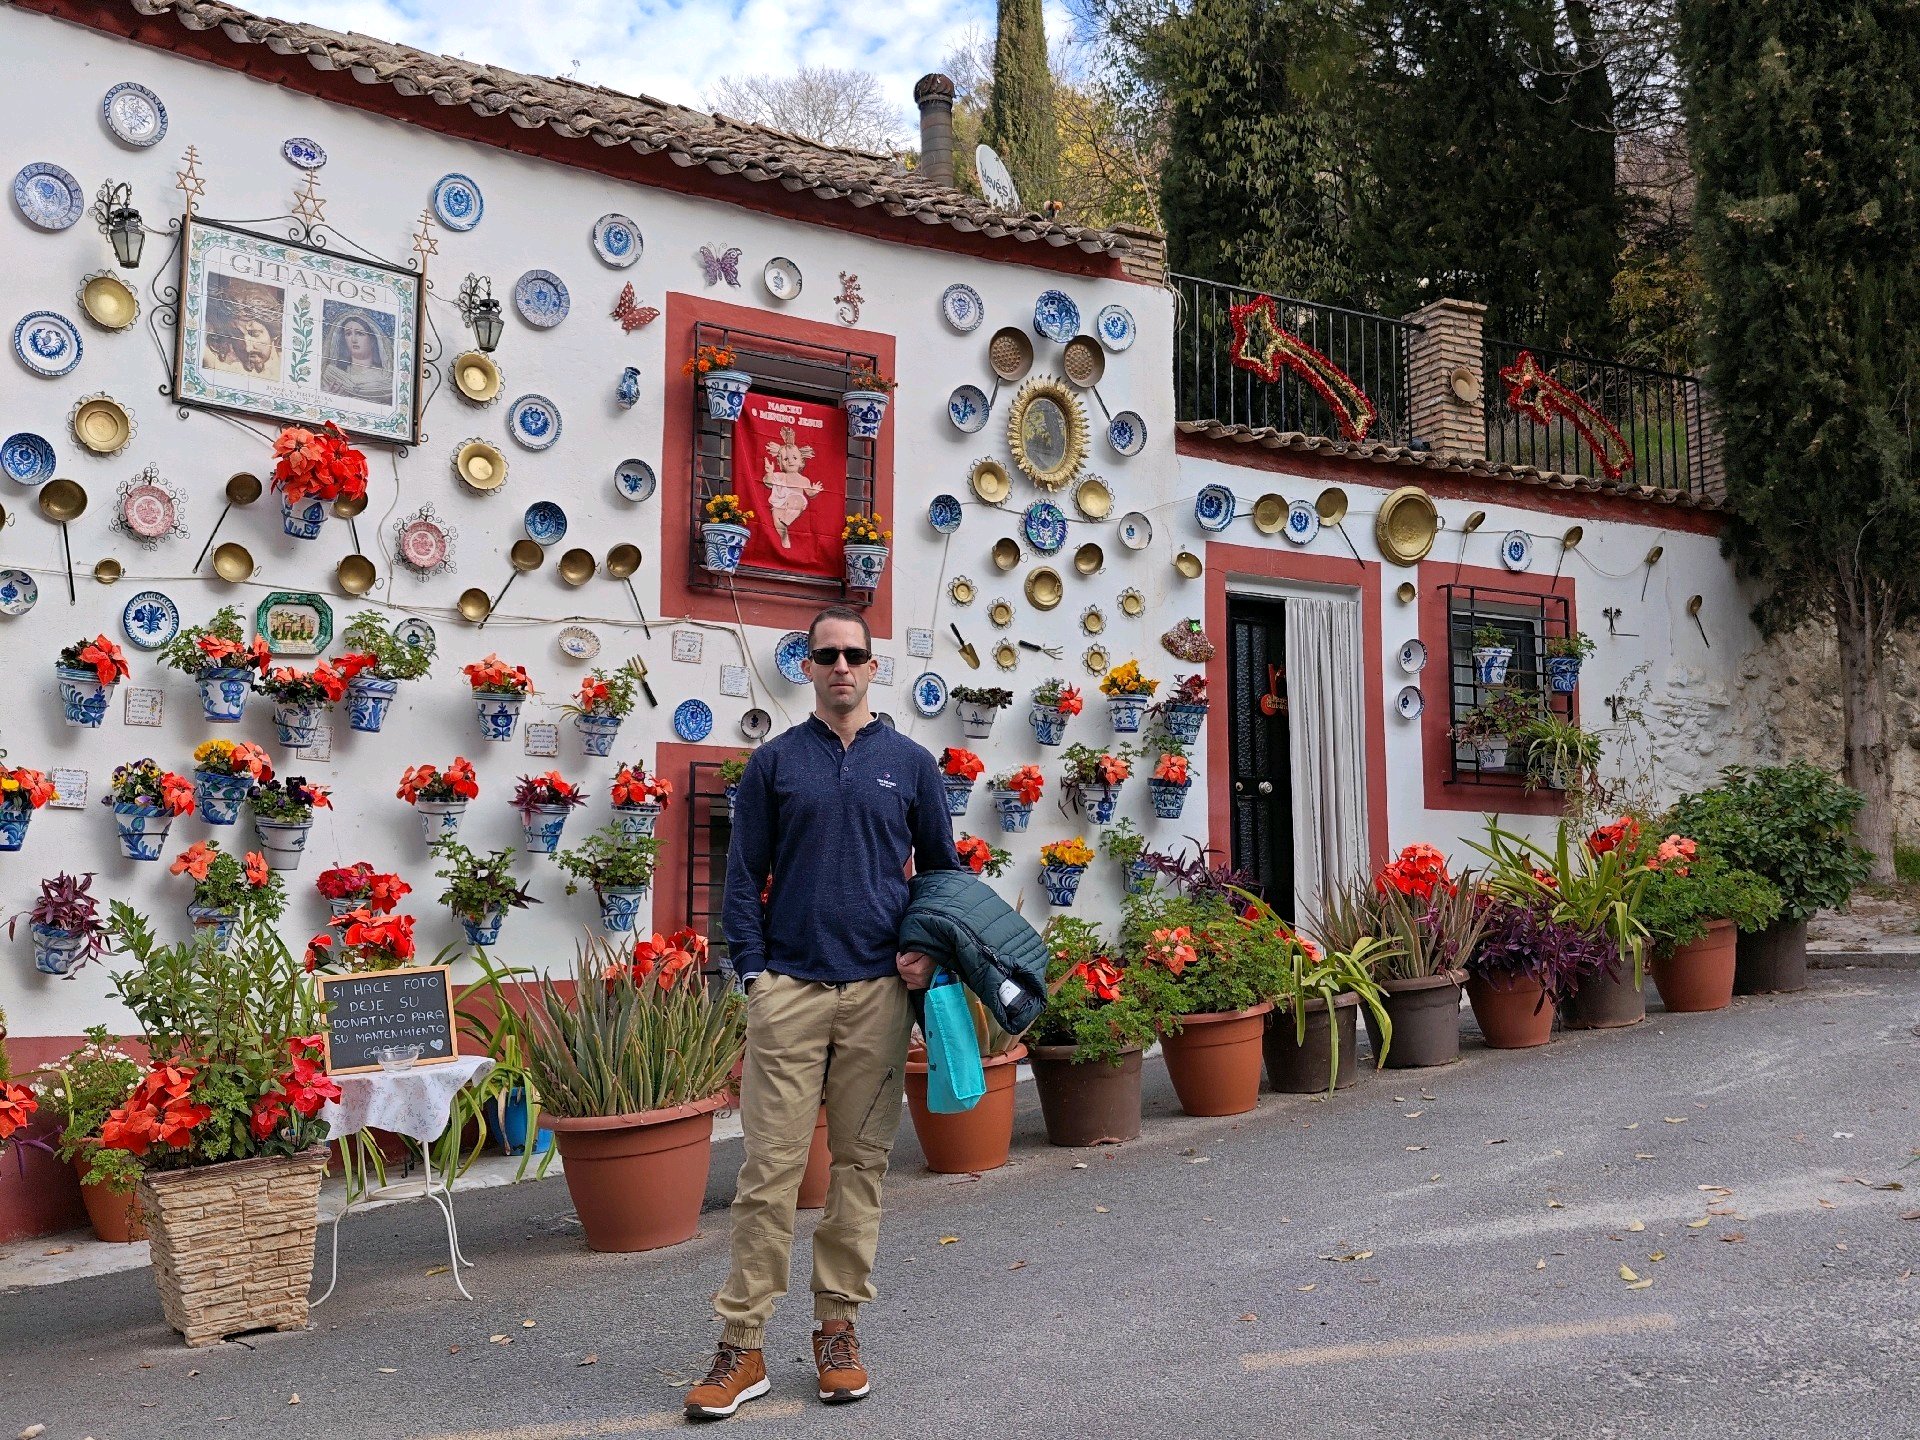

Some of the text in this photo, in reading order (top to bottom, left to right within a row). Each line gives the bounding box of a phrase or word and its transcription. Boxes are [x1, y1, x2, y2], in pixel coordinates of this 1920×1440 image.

[231, 254, 377, 304] GITANOS
[767, 401, 803, 415] NASCEU
[751, 408, 824, 429] O MENINO JESUS
[332, 977, 439, 998] SI HACE FOTO
[349, 996, 420, 1013] DEJE SU
[333, 1009, 445, 1029] DONATIVO PARA
[334, 1034, 349, 1045] SU
